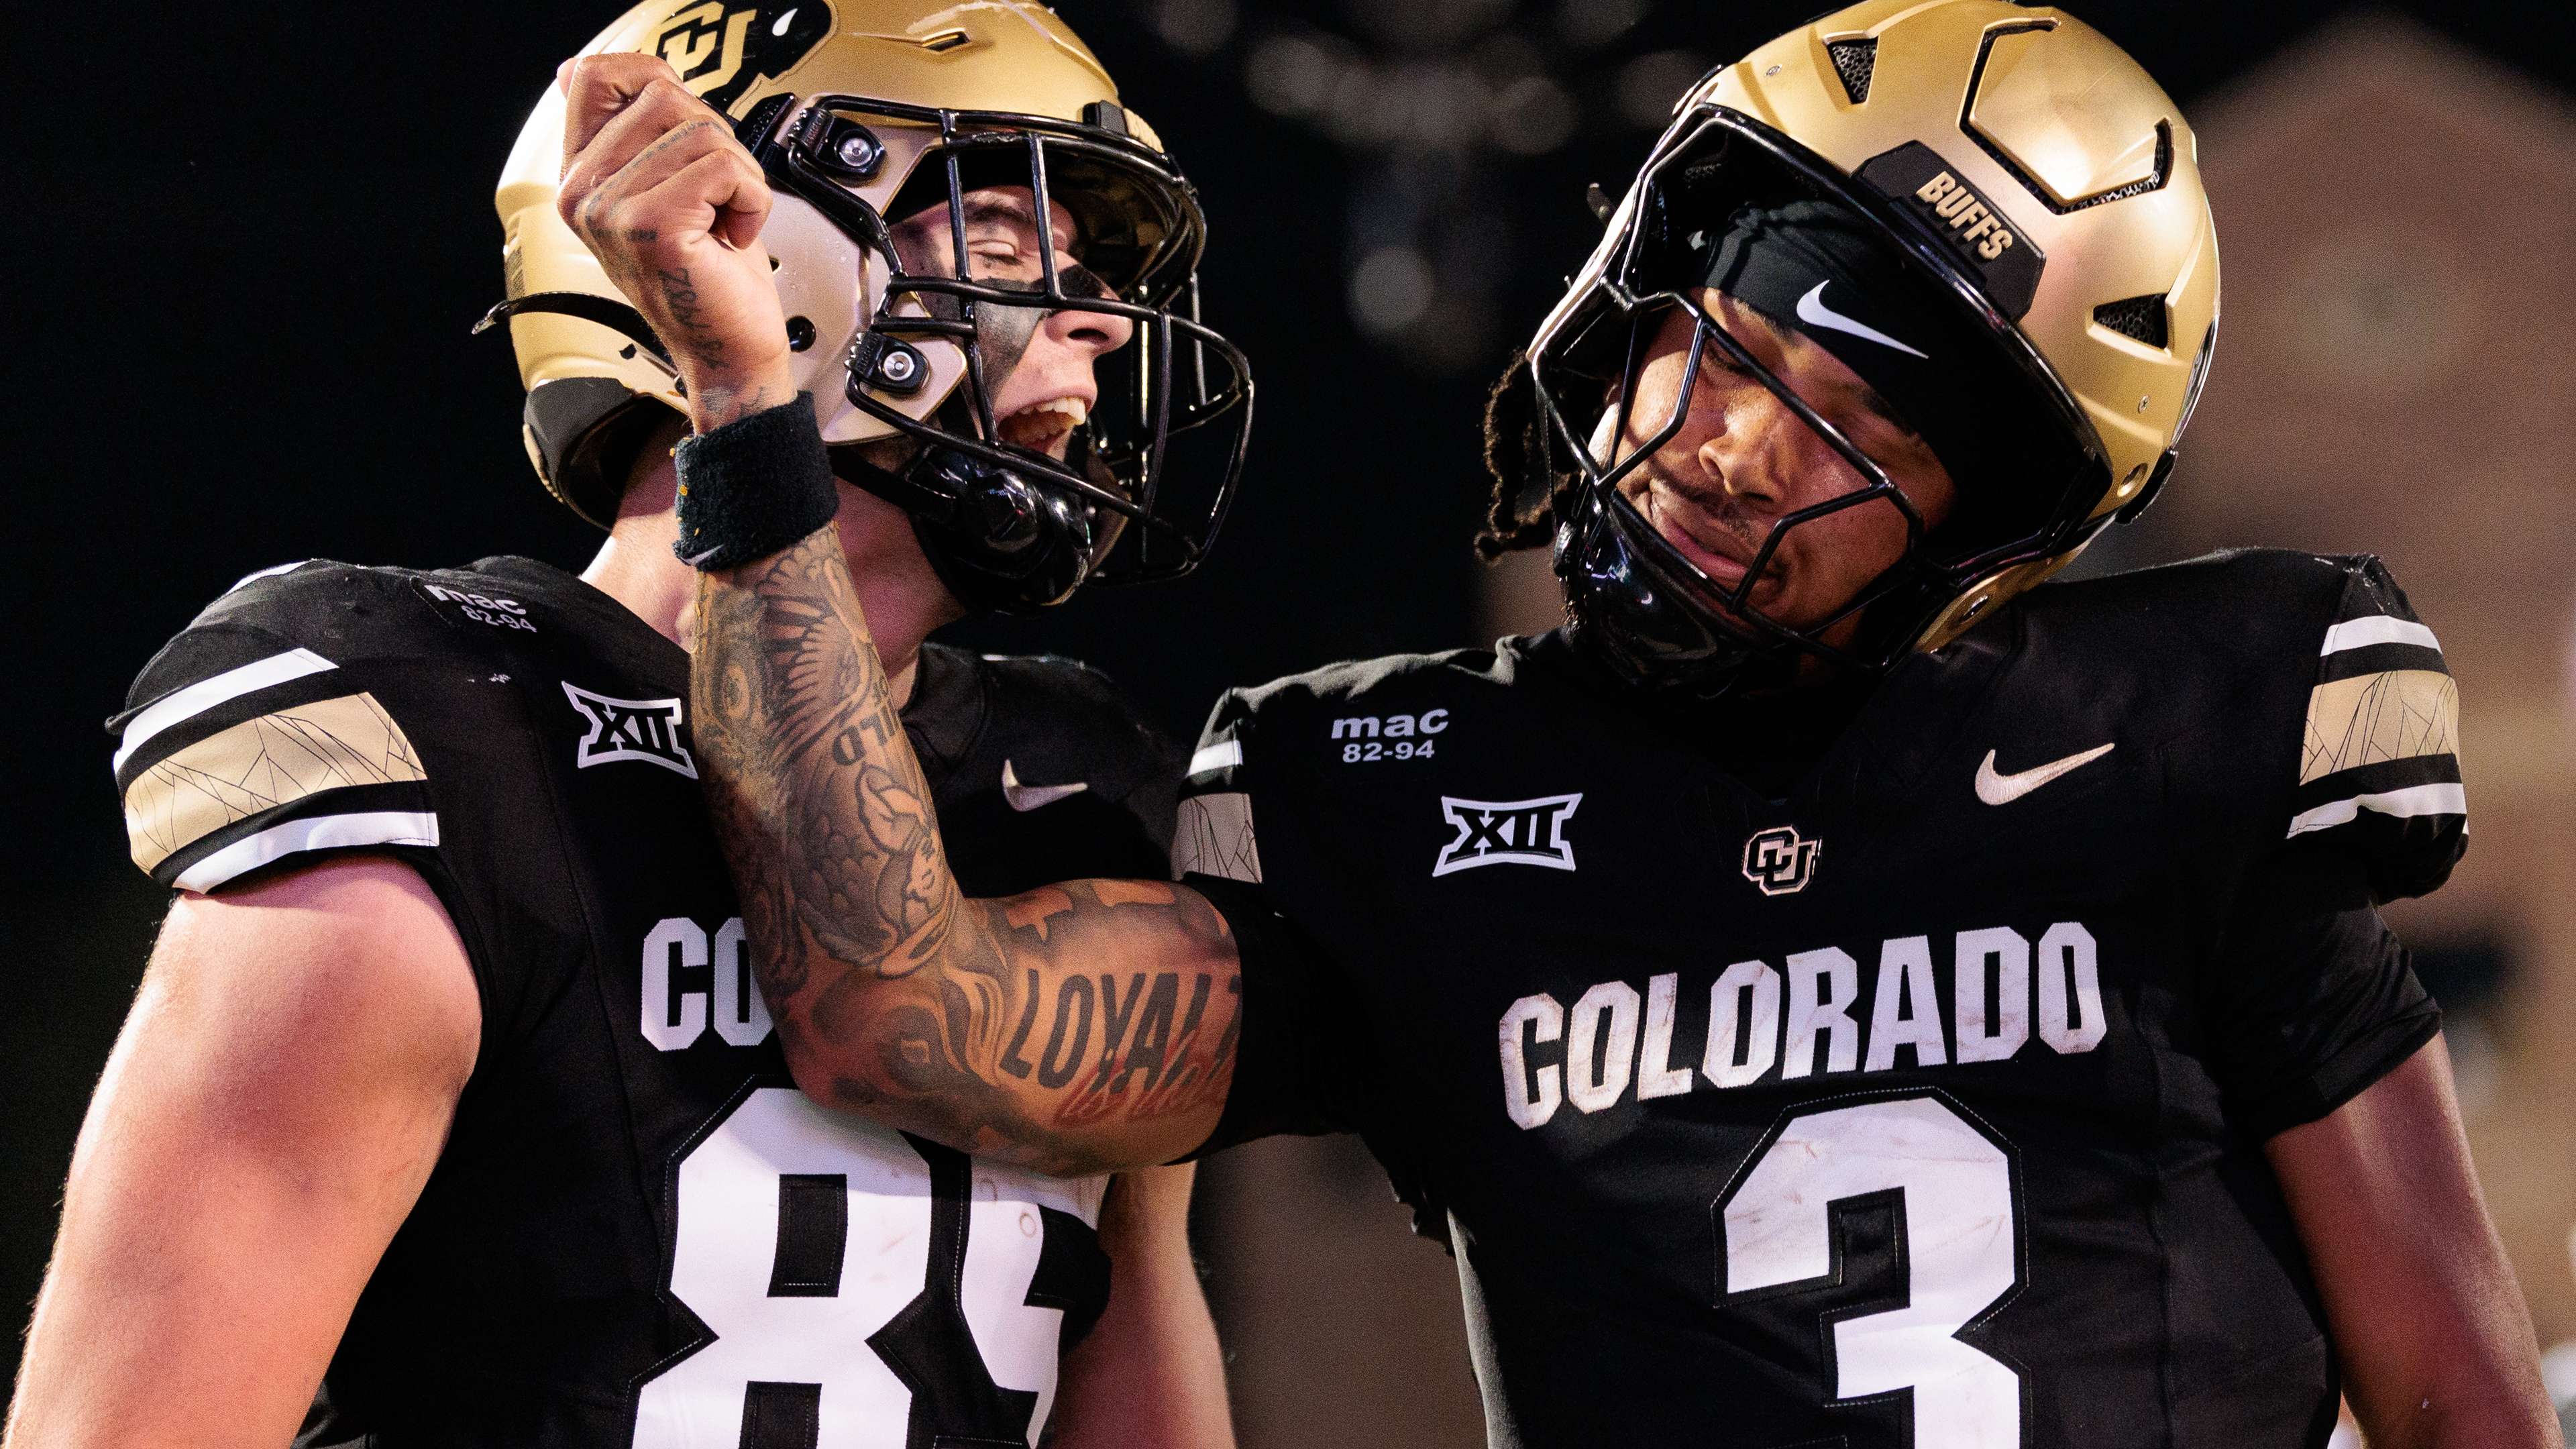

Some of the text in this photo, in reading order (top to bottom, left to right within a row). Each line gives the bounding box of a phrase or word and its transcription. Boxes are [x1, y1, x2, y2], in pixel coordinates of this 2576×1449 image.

[1916, 171, 2013, 260] BUFFS
[424, 585, 527, 614] mac
[462, 605, 537, 633] 82-94
[1331, 708, 1449, 739] mac
[1342, 740, 1435, 763] 82-94
[1742, 826, 1817, 896] CU
[1499, 922, 2107, 1130] COLORADO
[1723, 1096, 2021, 1449] 3
